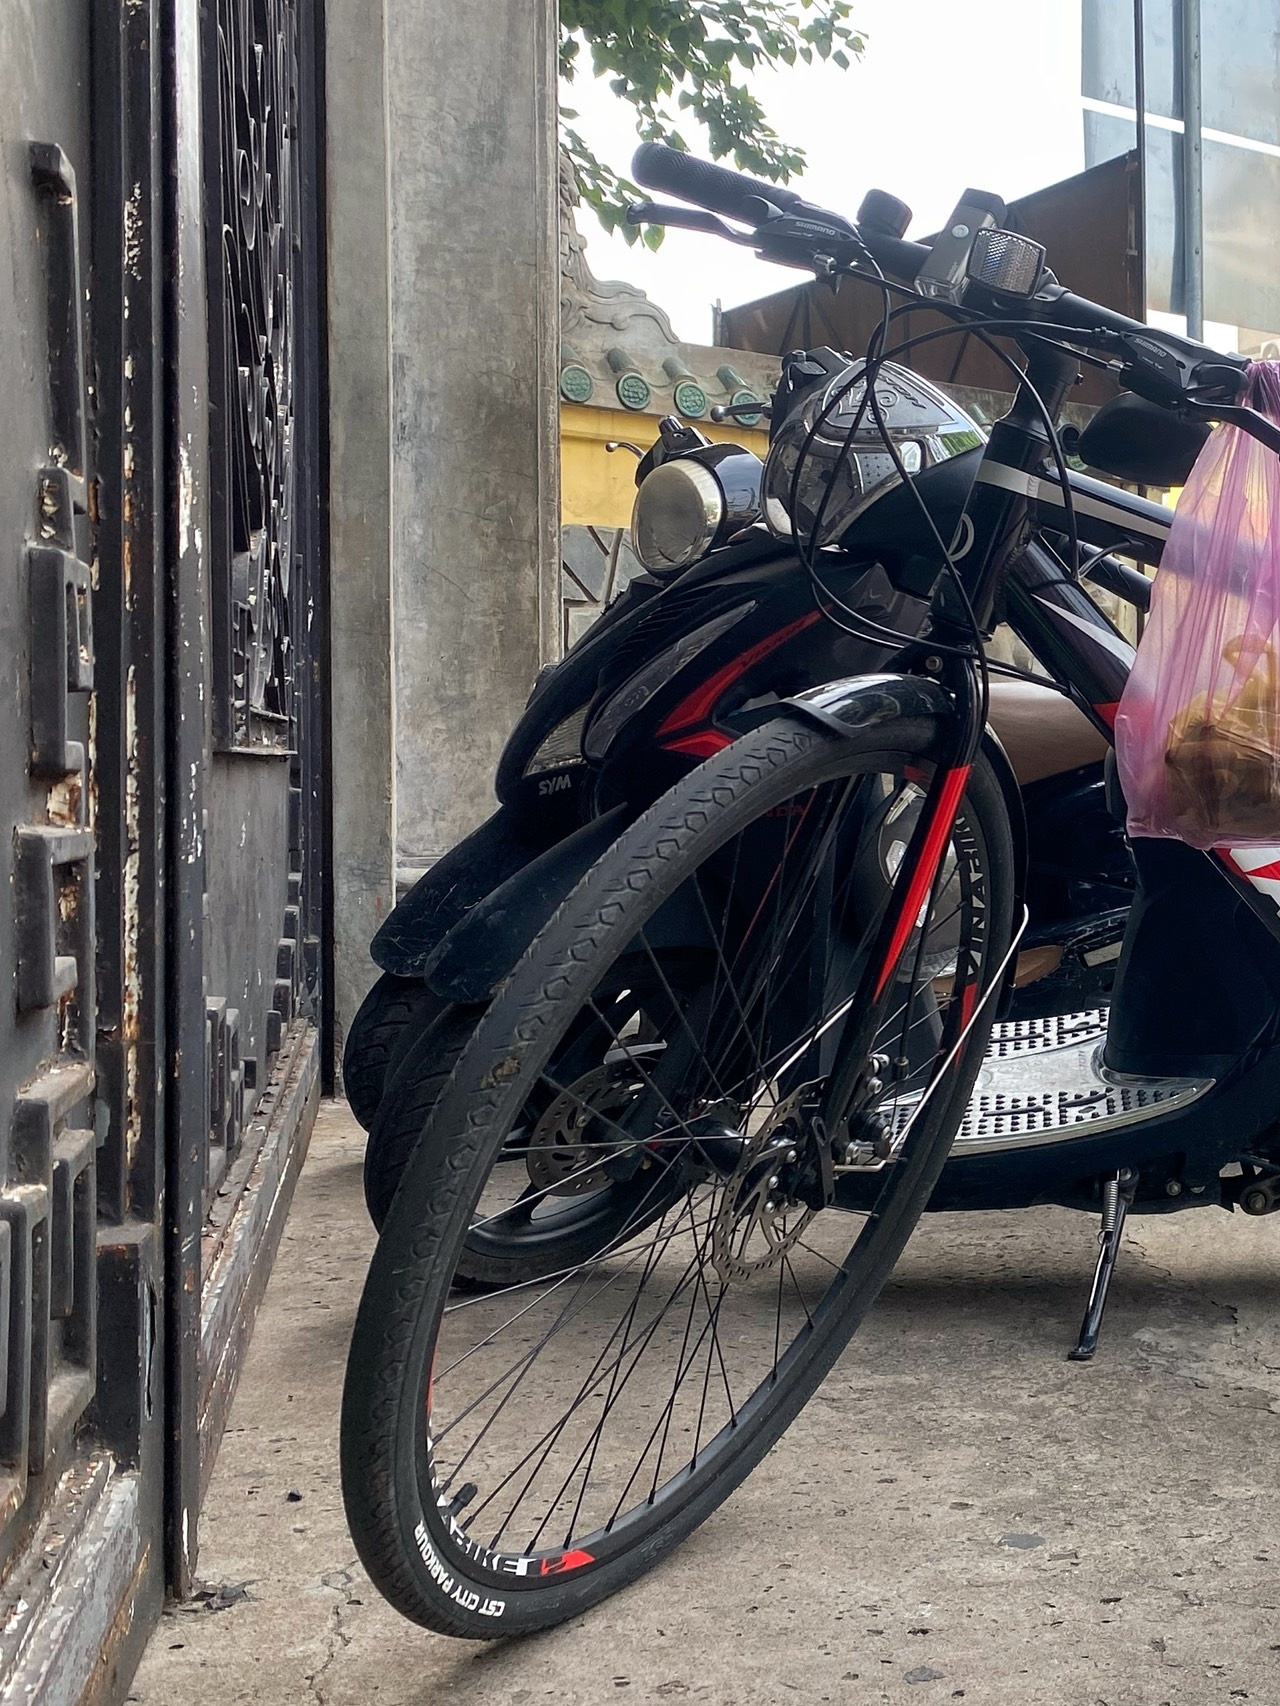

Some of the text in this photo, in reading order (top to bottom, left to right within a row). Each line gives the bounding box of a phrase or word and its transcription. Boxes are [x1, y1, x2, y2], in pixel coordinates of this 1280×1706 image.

[538, 774, 572, 796] SYM
[414, 1519, 506, 1617] CST CITY PARKOUR
